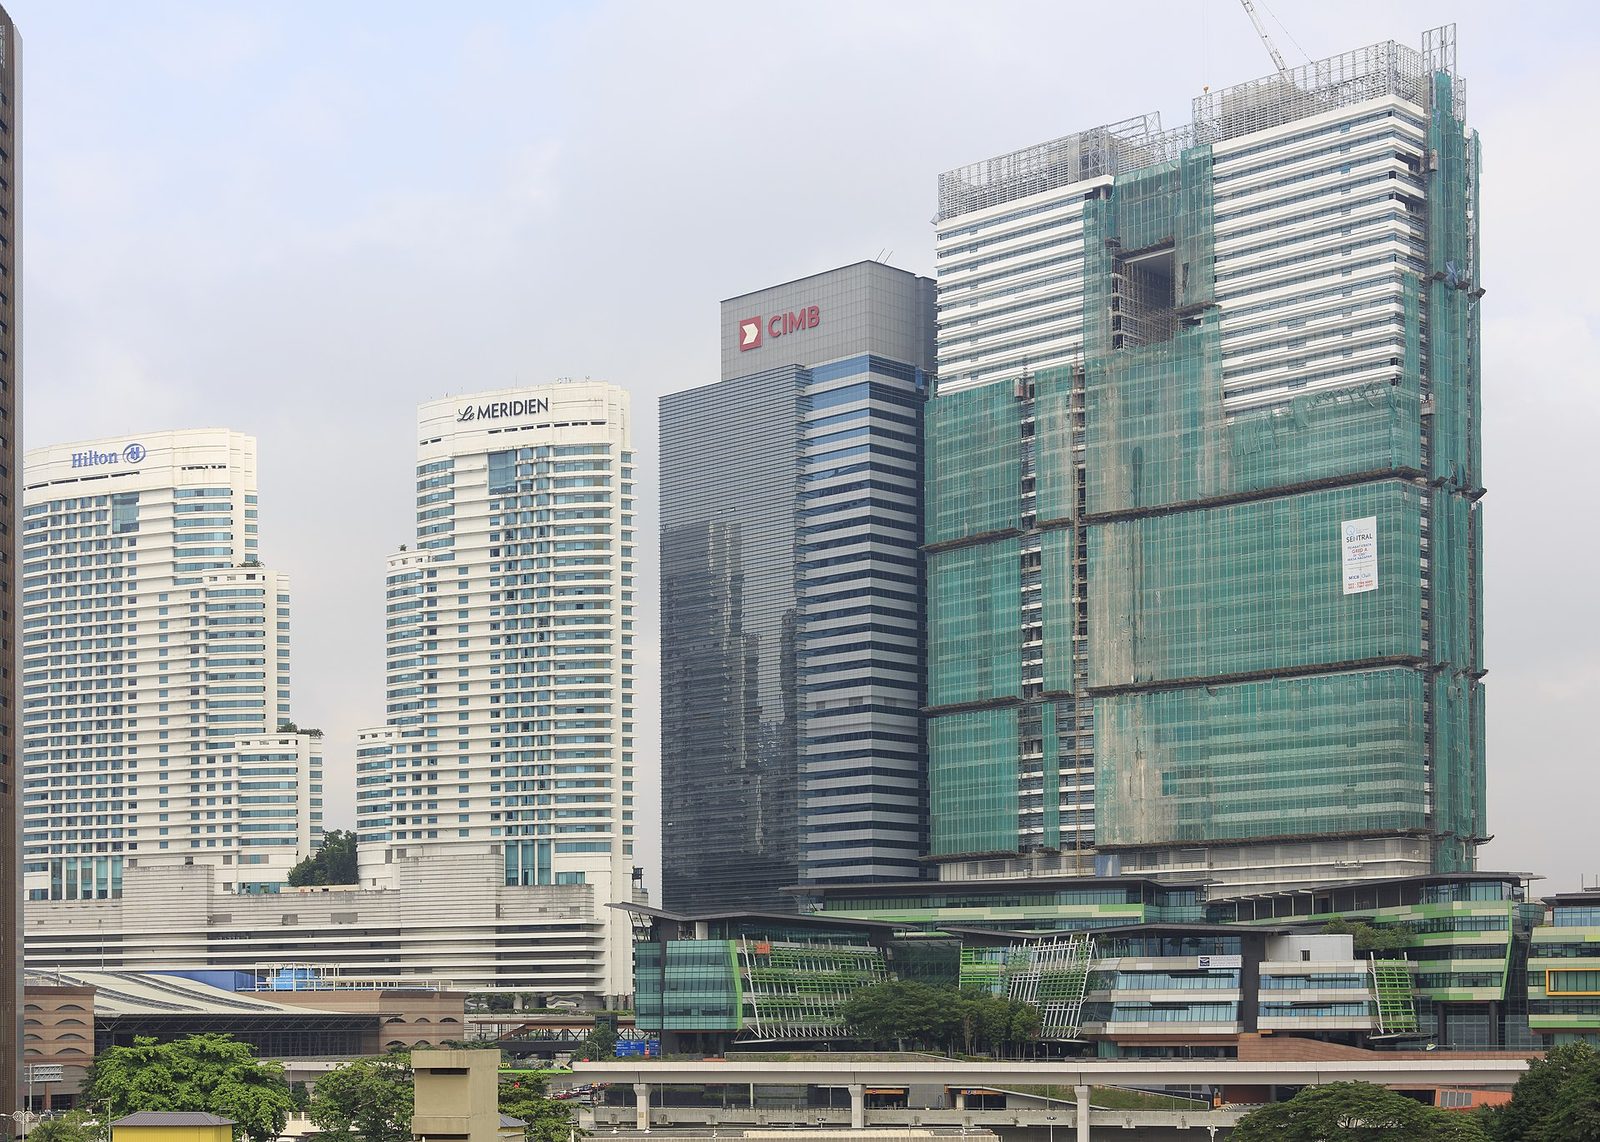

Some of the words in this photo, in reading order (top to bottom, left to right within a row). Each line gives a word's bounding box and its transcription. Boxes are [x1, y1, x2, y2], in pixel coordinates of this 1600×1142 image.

[768, 305, 820, 338] CIMB
[457, 405, 475, 422] Le
[477, 397, 549, 420] MERIDIEN
[71, 449, 119, 468] Hilton
